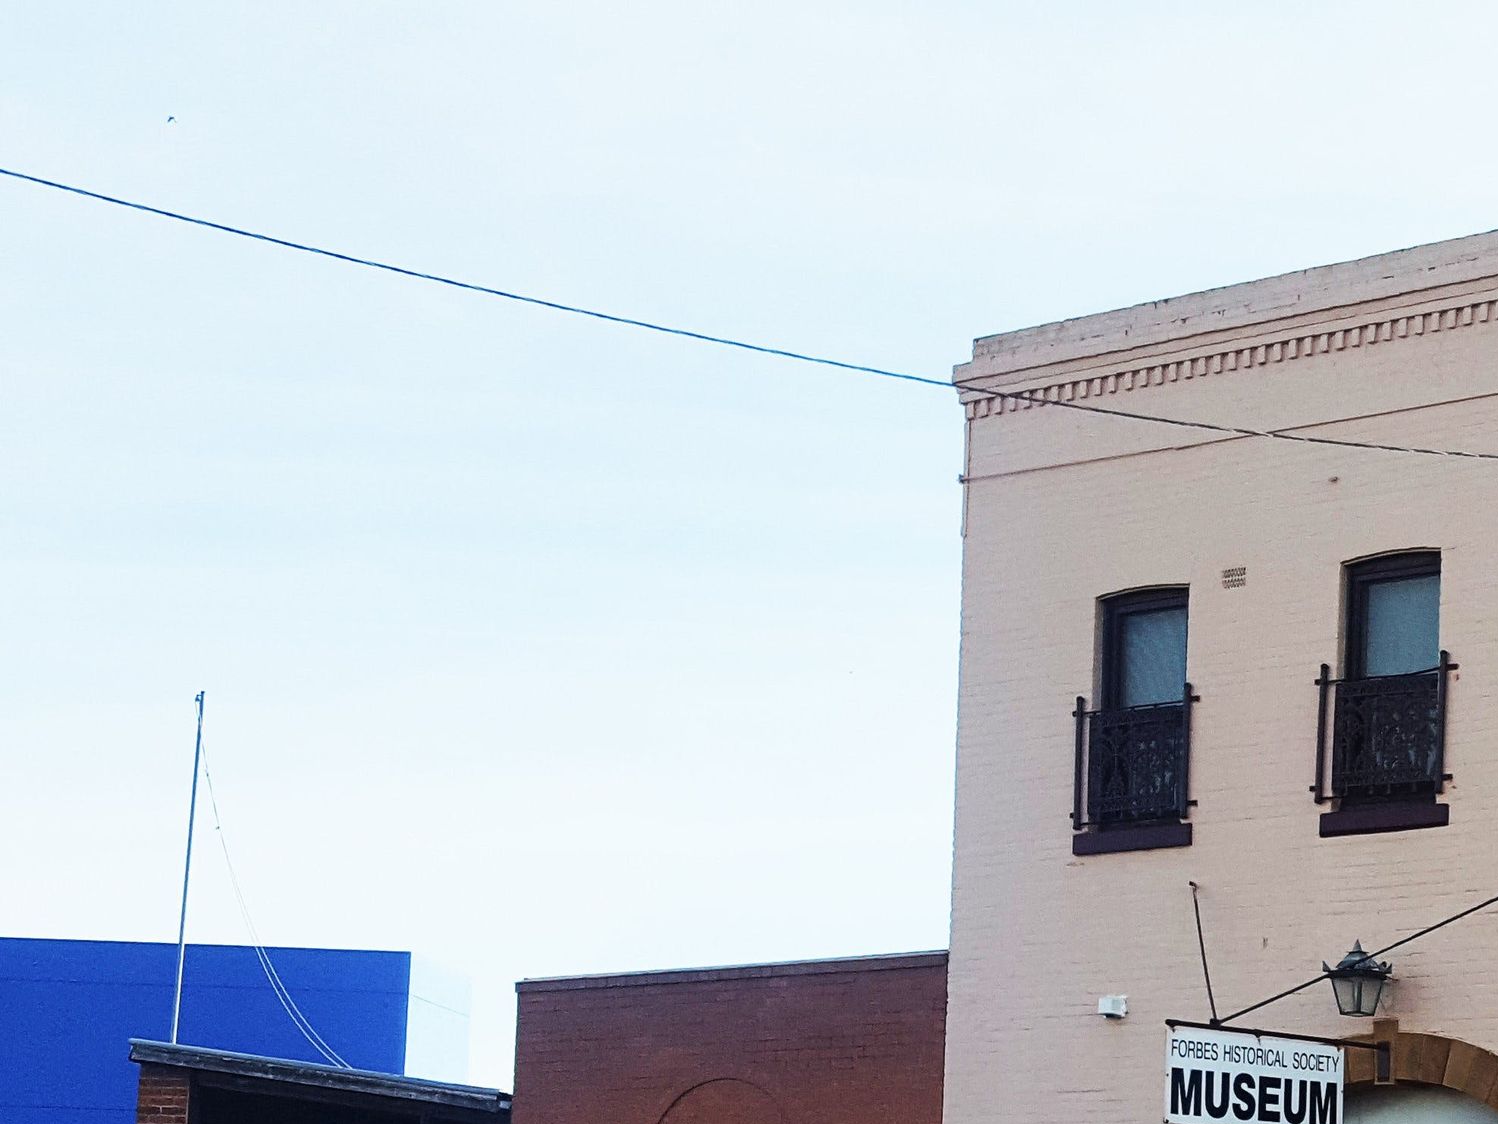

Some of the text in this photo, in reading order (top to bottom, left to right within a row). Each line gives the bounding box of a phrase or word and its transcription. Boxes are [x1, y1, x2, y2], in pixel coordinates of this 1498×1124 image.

[1171, 1039, 1340, 1073] FORBES HISTORICAL SOCIETY
